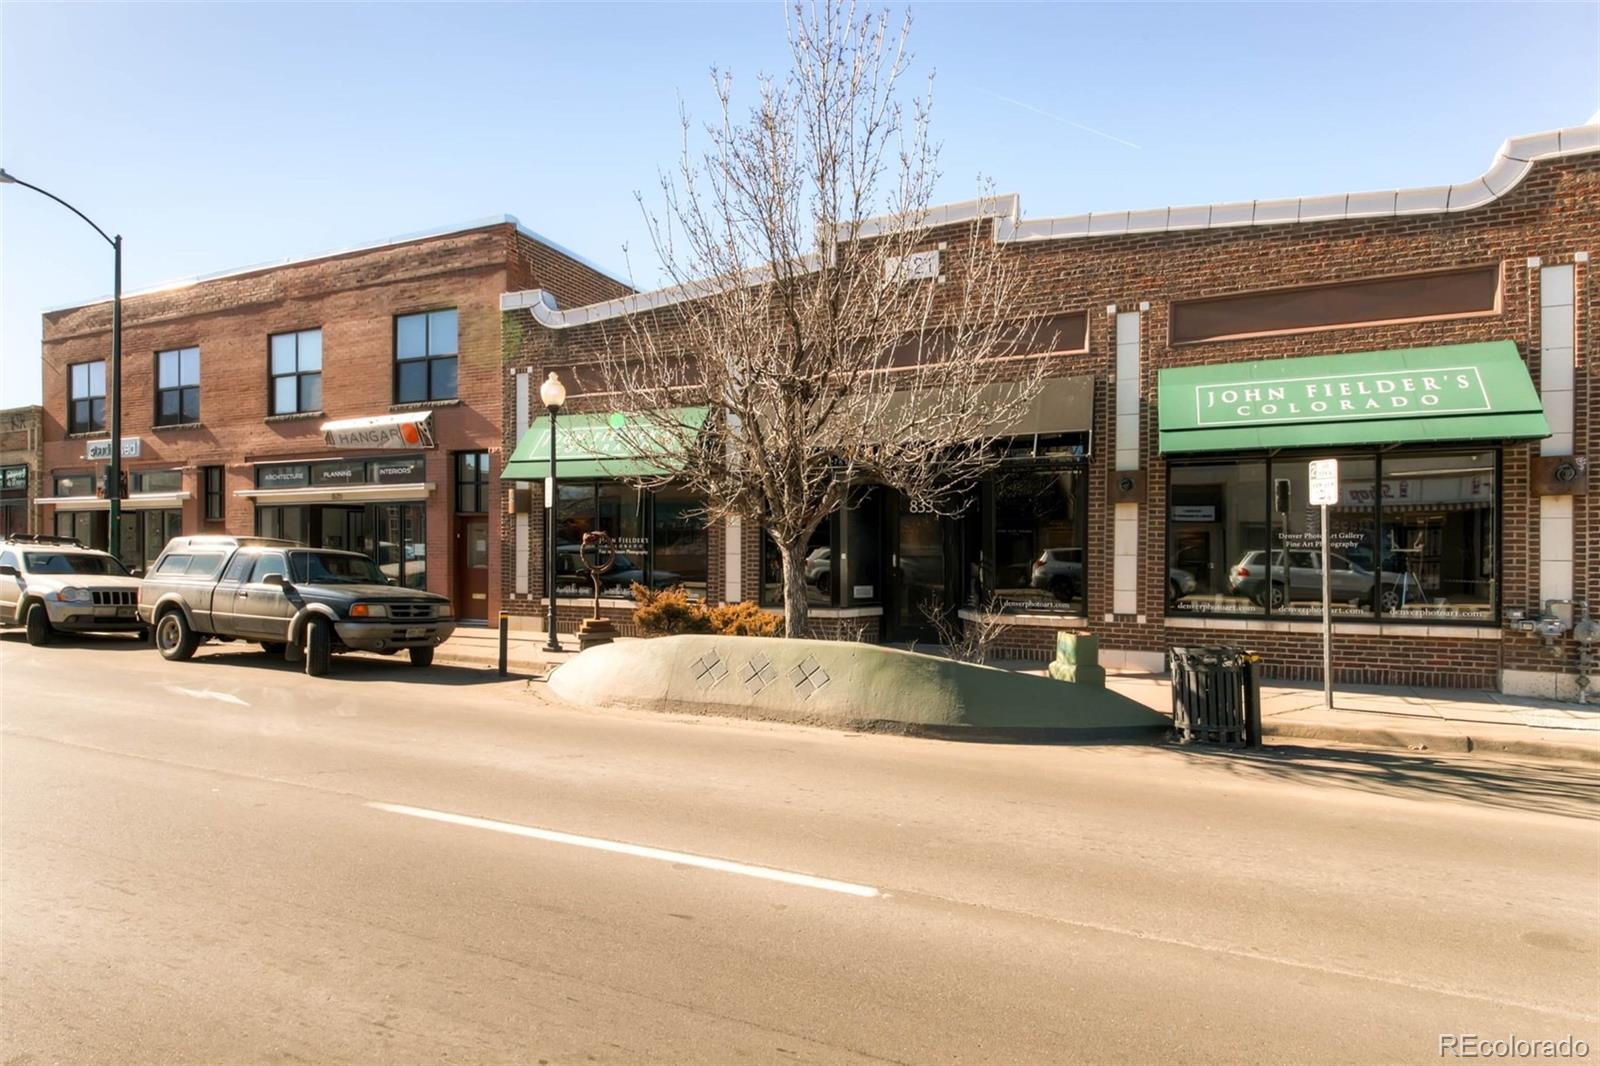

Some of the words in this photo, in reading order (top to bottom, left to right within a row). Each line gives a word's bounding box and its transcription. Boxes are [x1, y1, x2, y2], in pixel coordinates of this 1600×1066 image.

[1208, 386, 1285, 407] JOHN
[1305, 374, 1470, 398] FIELDER'S
[1236, 394, 1440, 416] COLORADO
[339, 429, 400, 444] HANGAR
[323, 470, 352, 479] PLANNING
[379, 467, 412, 475] INTERIORS
[265, 472, 304, 481] ARCHITECTURE
[909, 500, 934, 514] 833
[1338, 532, 1365, 541] Gallery
[1004, 600, 1070, 609] denverphotoart.com
[1389, 607, 1482, 618] denverphotoart.com
